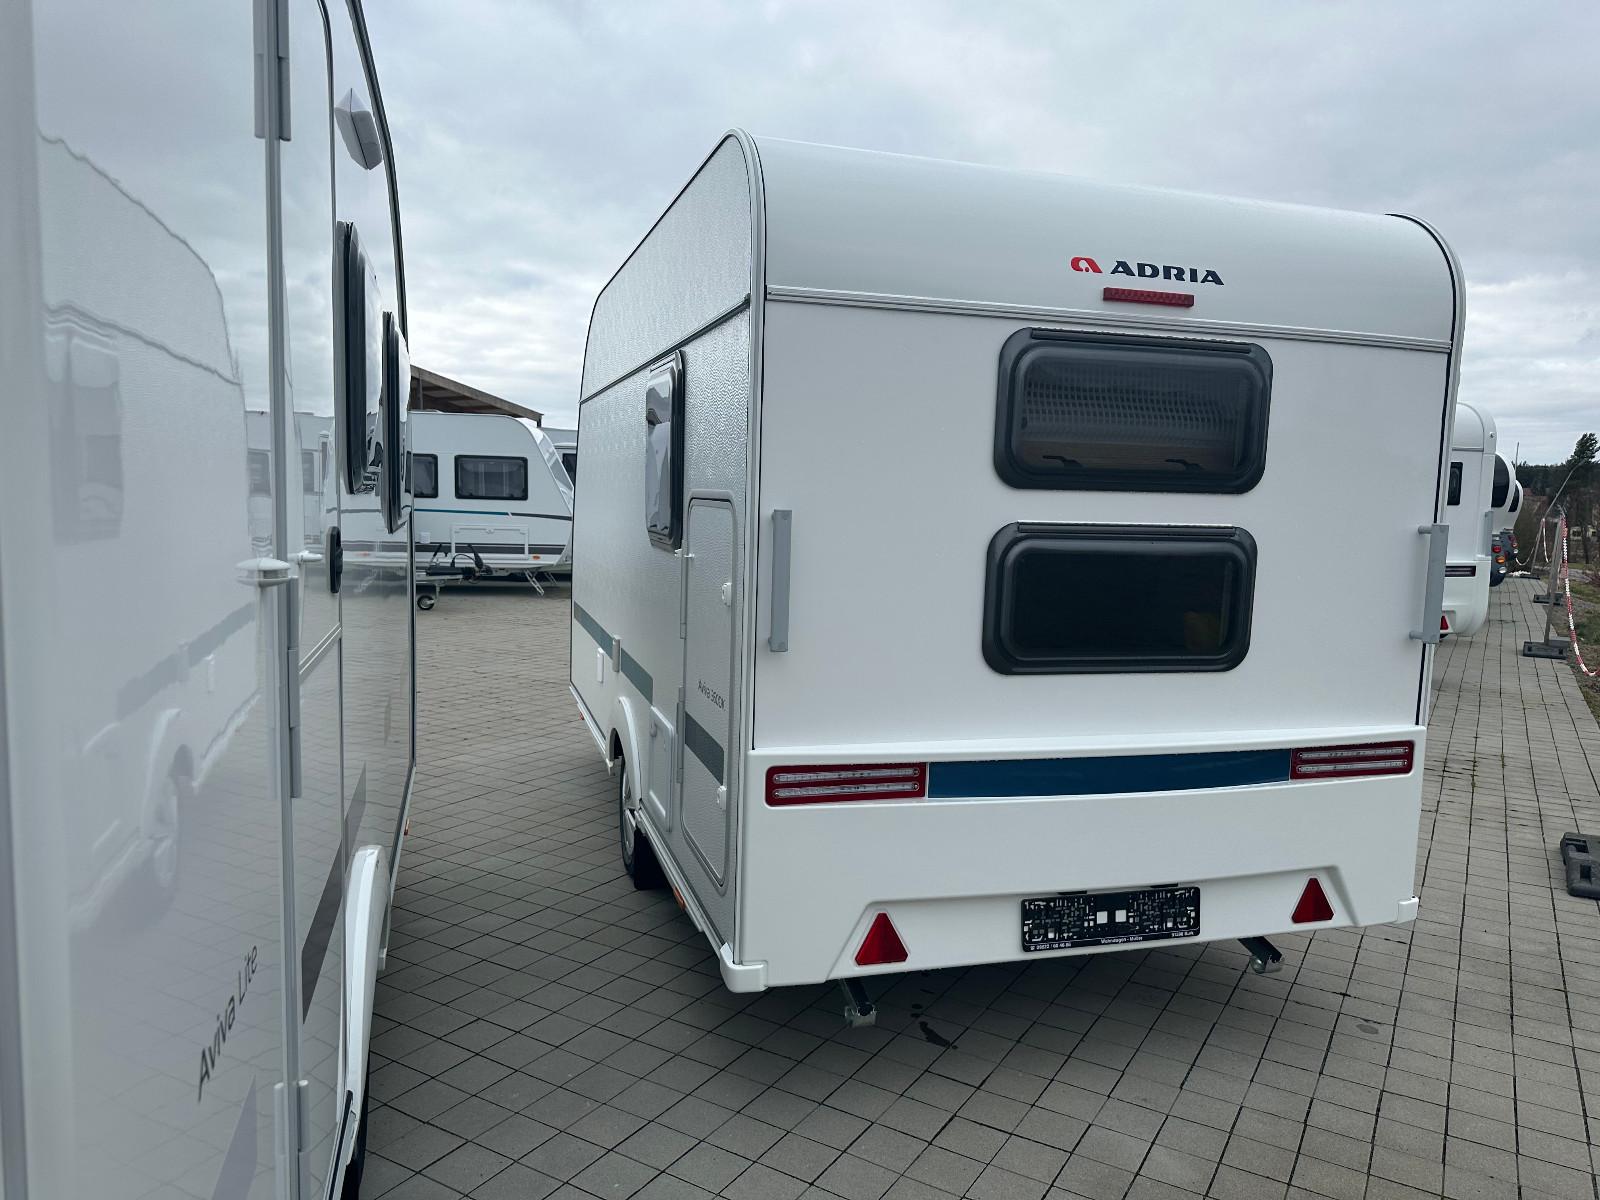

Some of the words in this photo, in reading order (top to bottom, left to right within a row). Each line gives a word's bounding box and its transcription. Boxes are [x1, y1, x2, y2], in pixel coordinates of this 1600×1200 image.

[1110, 260, 1225, 286] ADRIA
[198, 994, 236, 1103] Aviva
[238, 944, 258, 1007] Lite
